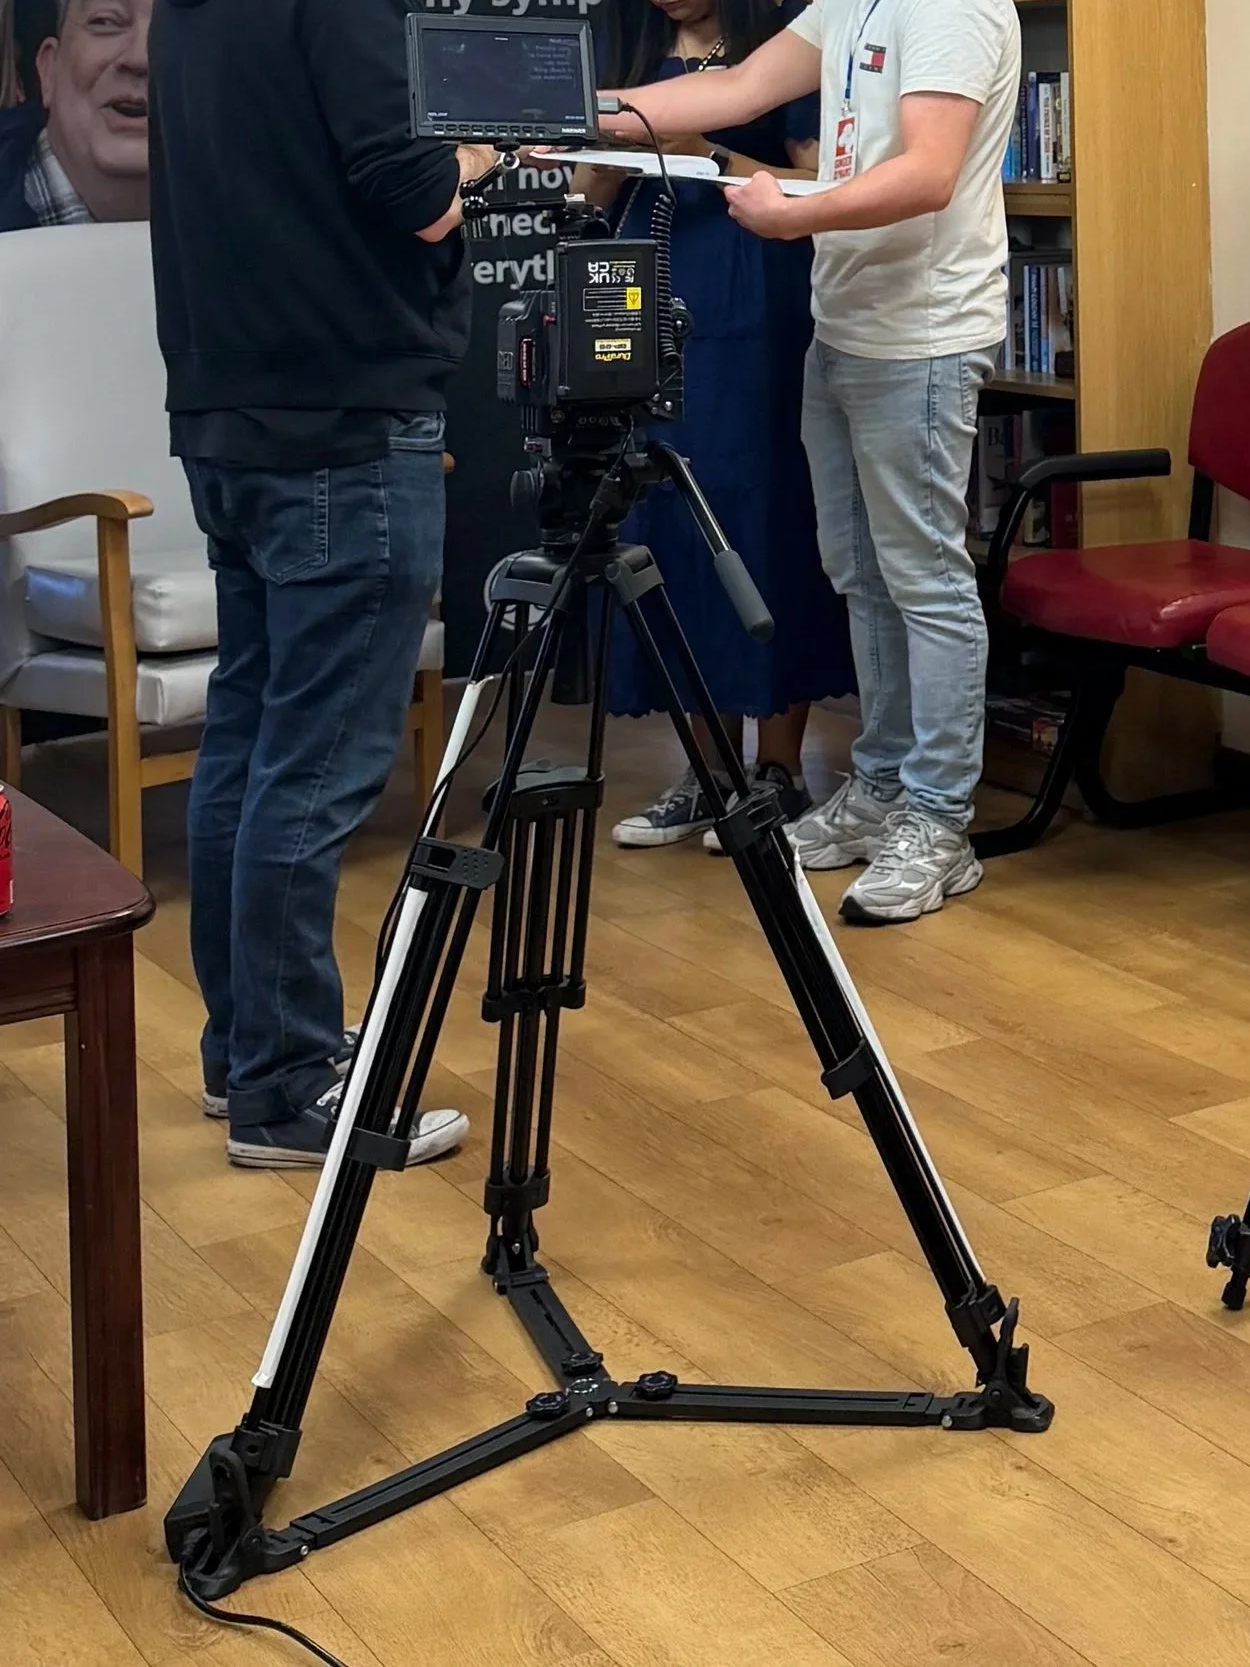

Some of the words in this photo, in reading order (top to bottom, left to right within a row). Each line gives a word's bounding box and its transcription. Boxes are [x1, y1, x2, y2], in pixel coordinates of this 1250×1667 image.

[471, 250, 554, 290] eryt
[588, 261, 609, 273] CA
[589, 273, 610, 283] UK
